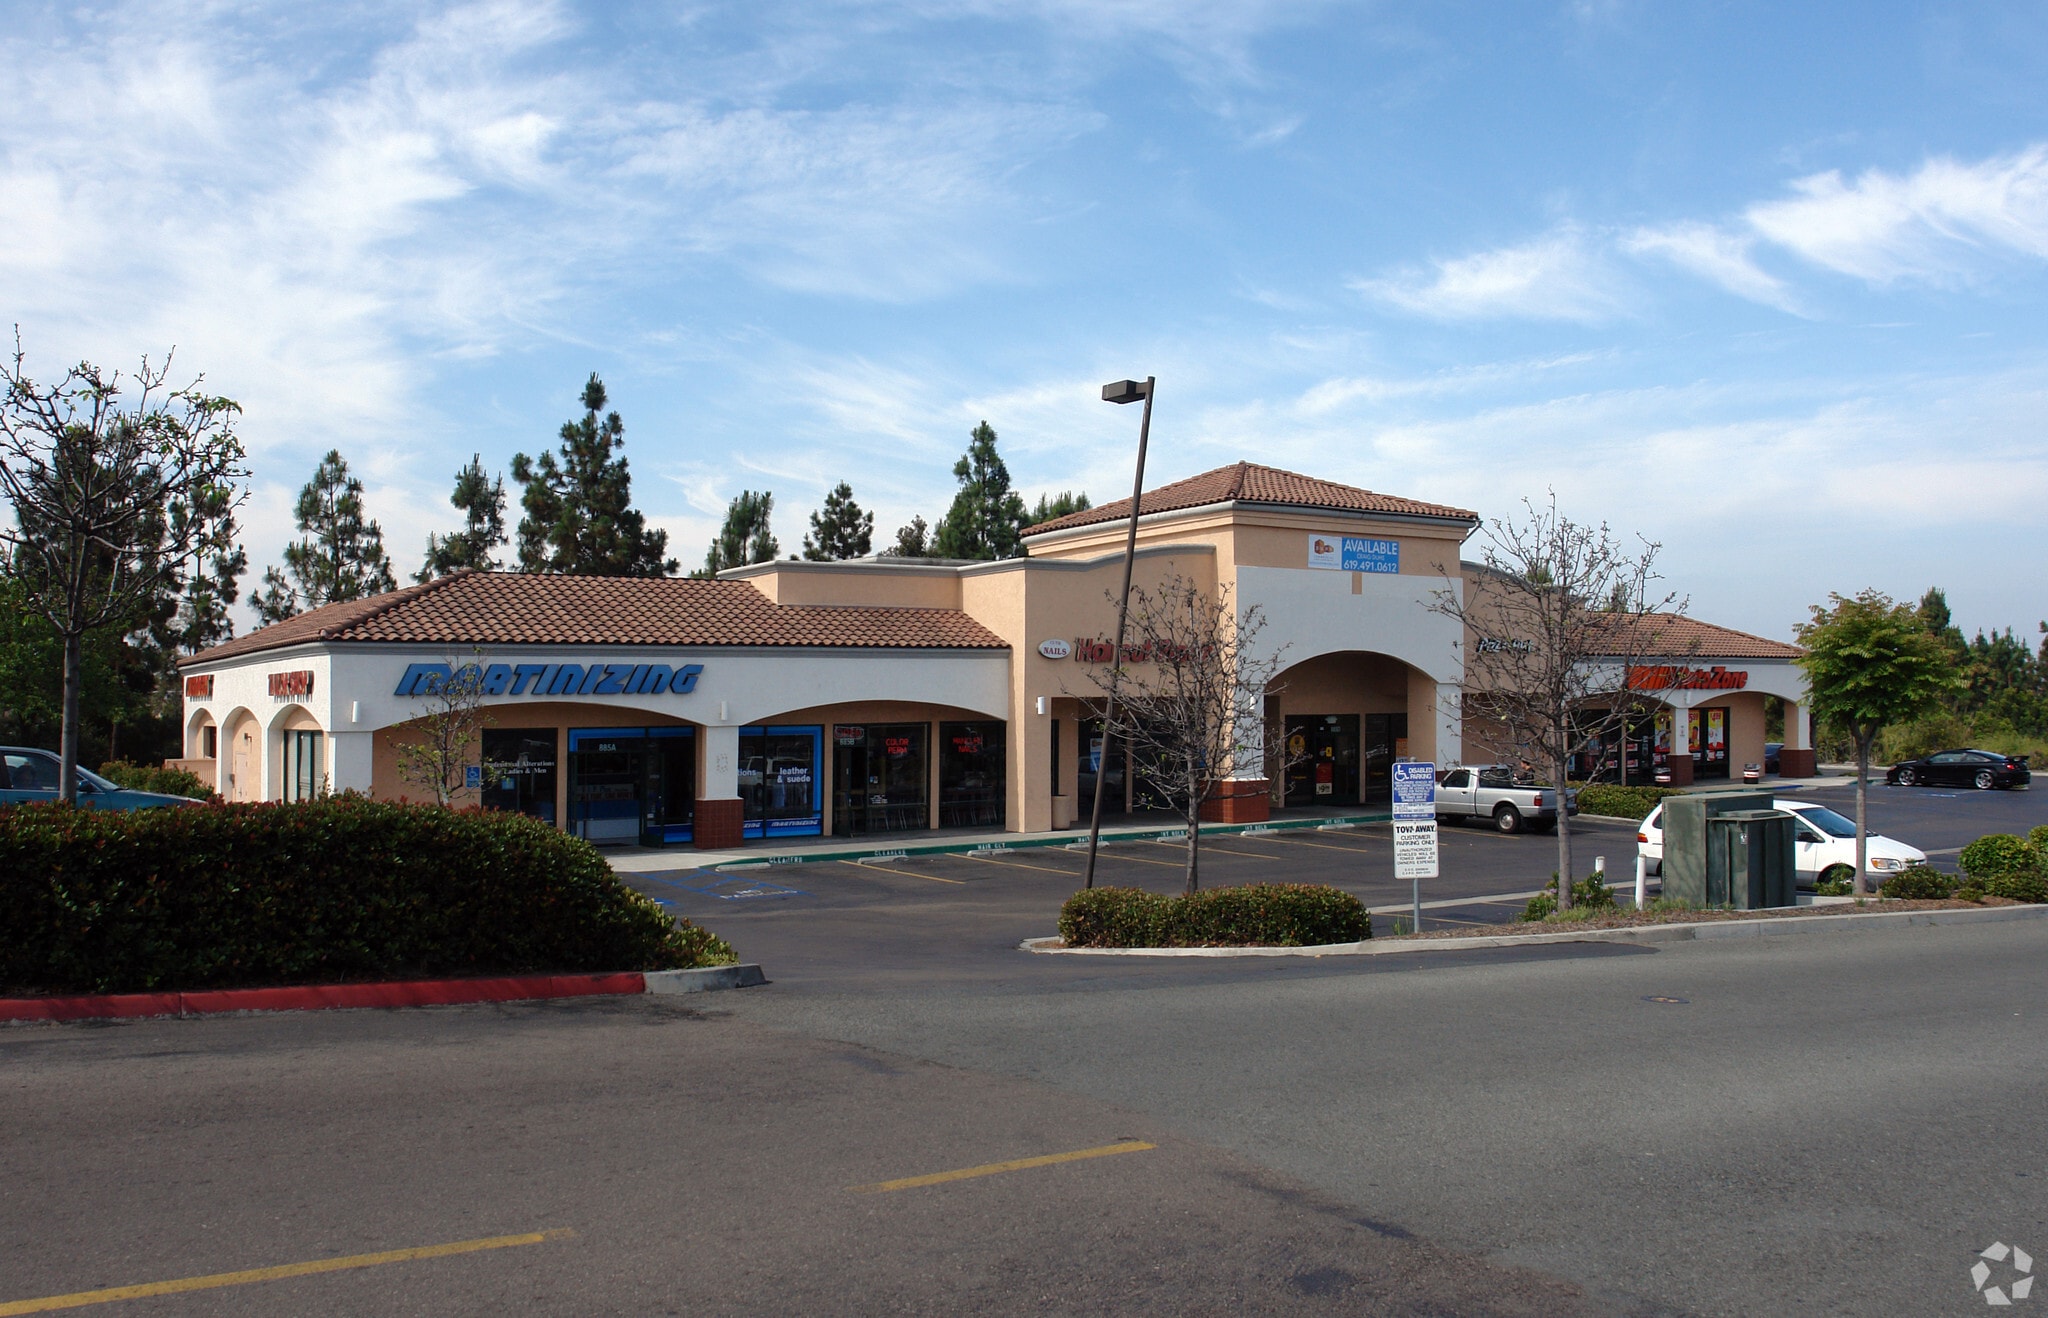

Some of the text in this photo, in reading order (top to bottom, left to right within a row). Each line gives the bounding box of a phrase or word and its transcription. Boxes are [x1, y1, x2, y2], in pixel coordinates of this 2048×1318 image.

[1343, 540, 1397, 555] AVAILABLE
[1343, 560, 1397, 572] 619.491.0612
[1043, 647, 1067, 656] NAILS
[393, 663, 704, 696] MARTINIZING
[886, 738, 908, 746] COLOR
[599, 743, 616, 752] 885A
[780, 766, 808, 775] leather
[777, 775, 811, 783] & suede
